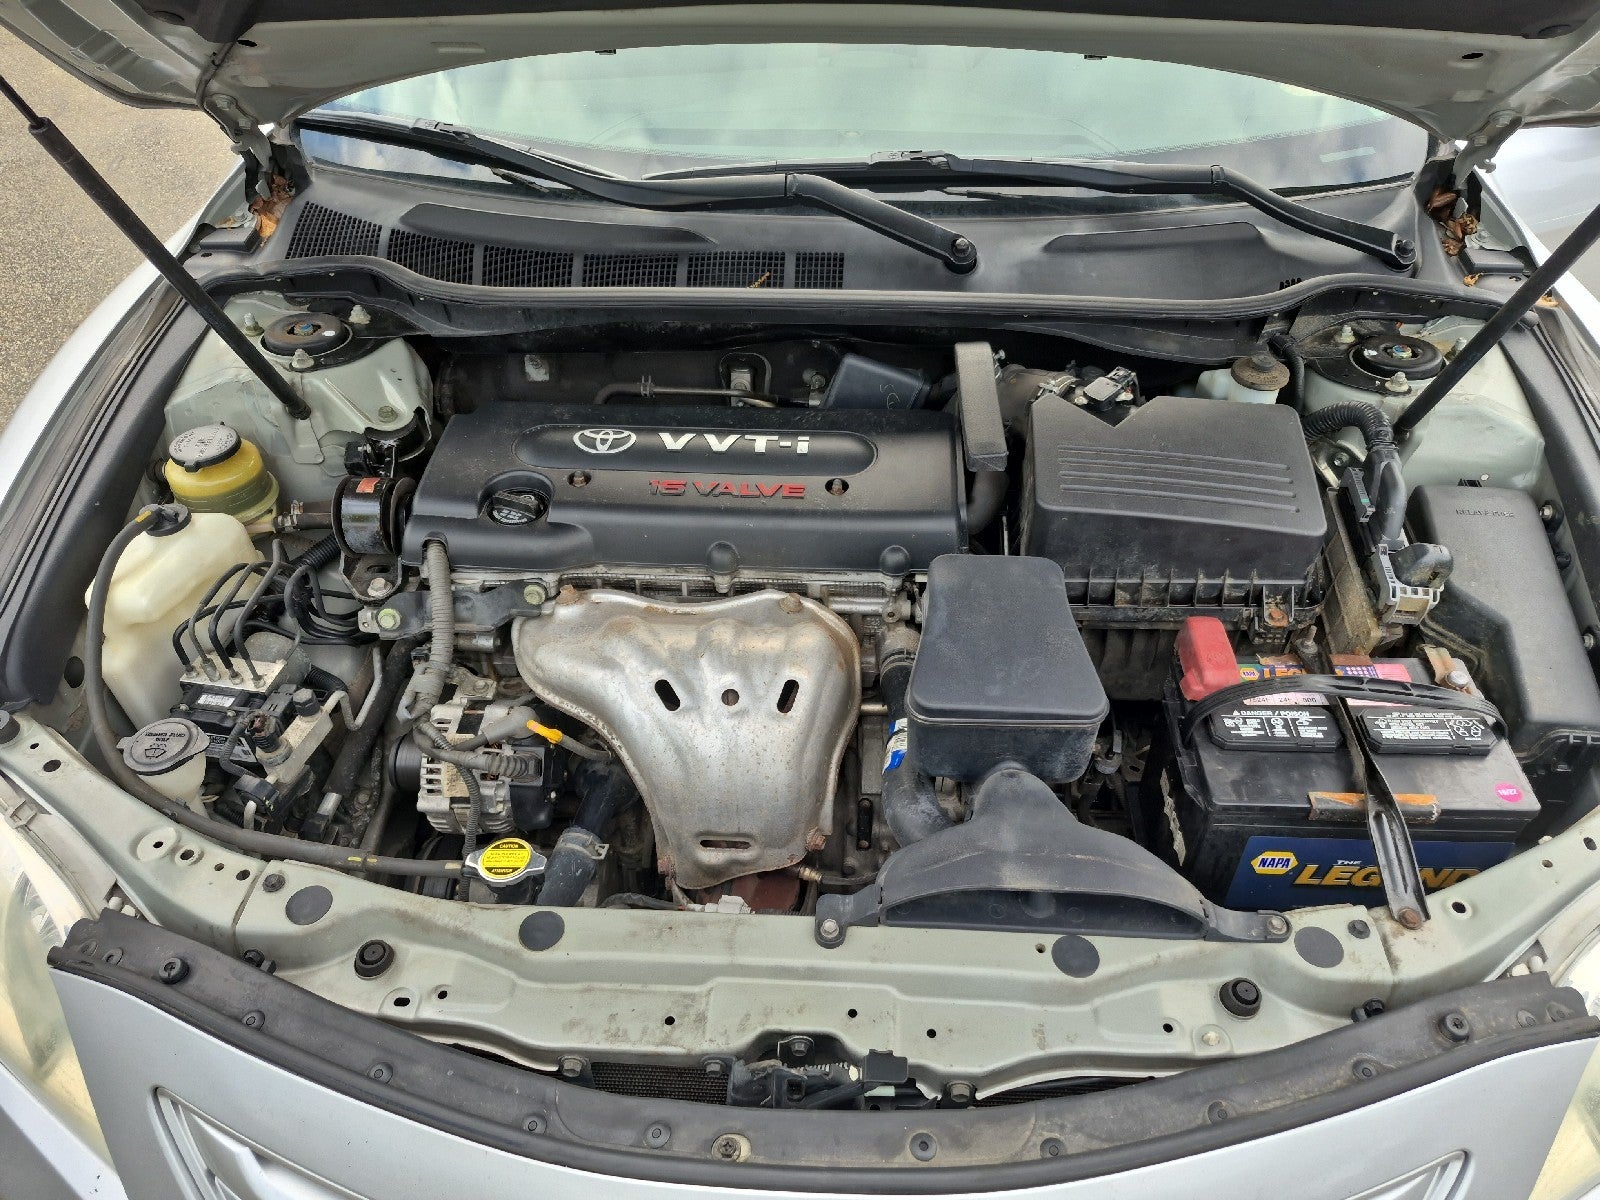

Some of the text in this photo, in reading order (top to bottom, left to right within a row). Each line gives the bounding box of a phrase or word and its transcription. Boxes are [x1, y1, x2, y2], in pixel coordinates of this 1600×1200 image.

[658, 432, 810, 454] VVT-i
[692, 481, 806, 499] VALVE
[1258, 857, 1292, 869] NAPA
[1293, 864, 1483, 890] LEGND
